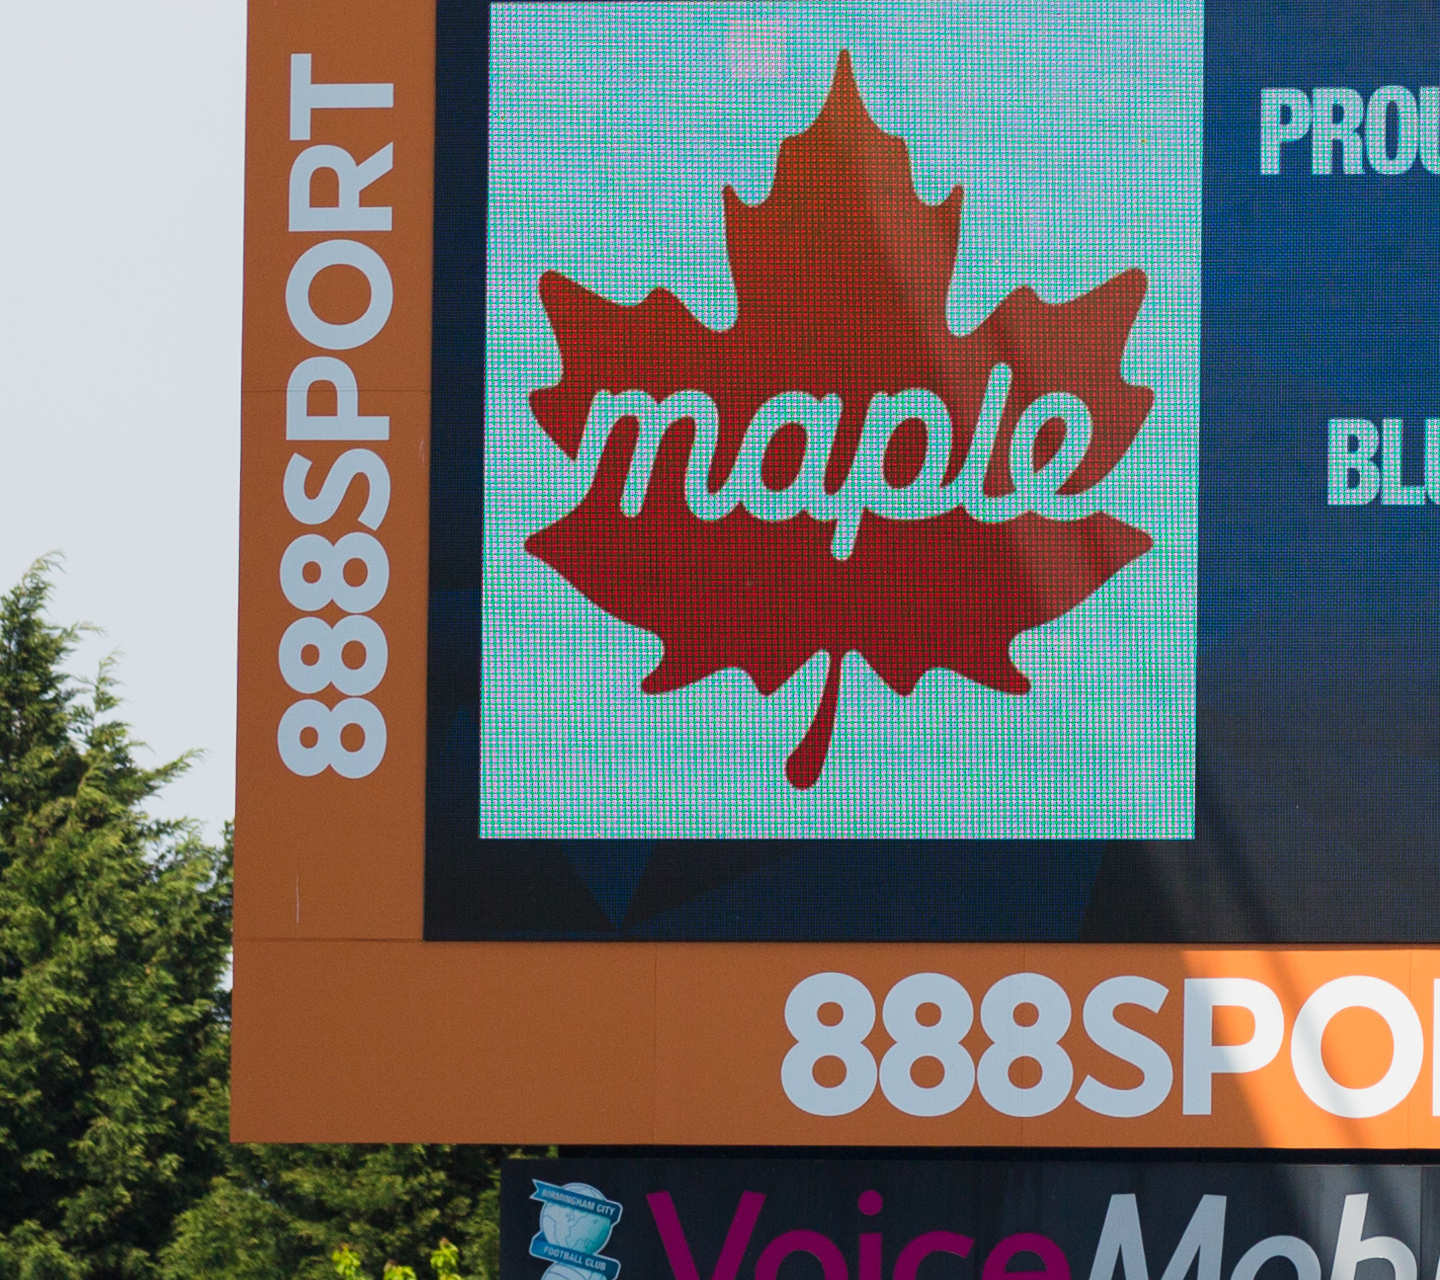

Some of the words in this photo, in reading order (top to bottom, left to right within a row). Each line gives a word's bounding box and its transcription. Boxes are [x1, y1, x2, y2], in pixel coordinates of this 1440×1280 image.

[276, 52, 394, 780] 888SPORT
[572, 362, 1094, 561] maple
[541, 1189, 595, 1211] BIRMINGHAM
[596, 1204, 616, 1216] CITY
[544, 1246, 583, 1265] FOOTBALL
[585, 1259, 607, 1271] CLUB
